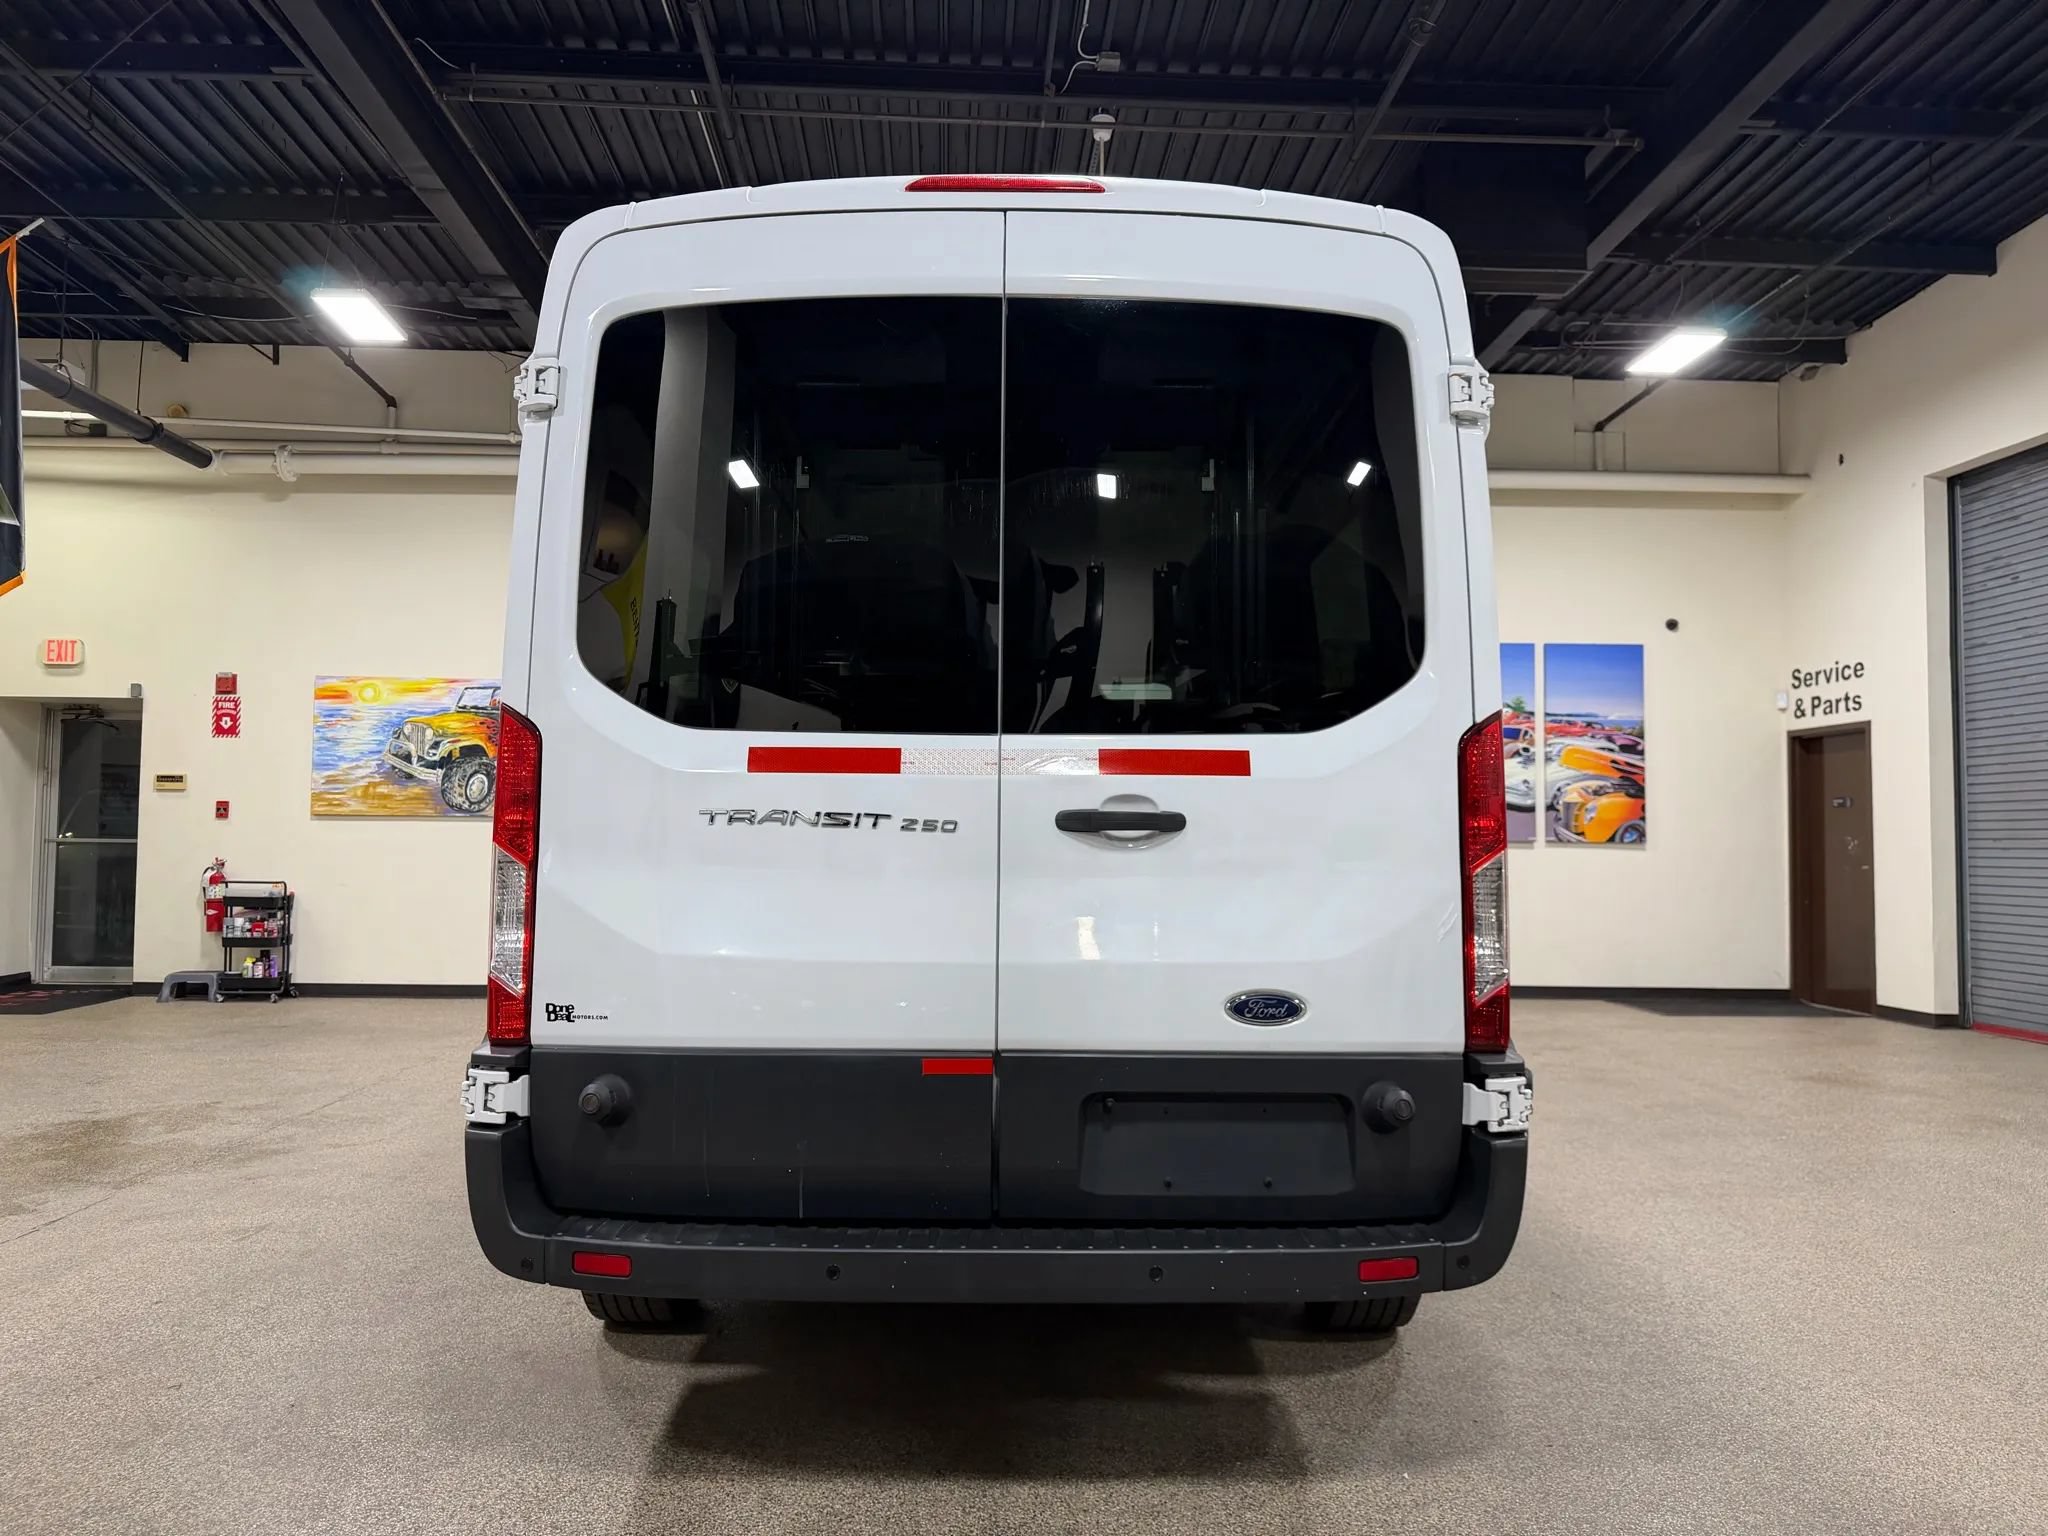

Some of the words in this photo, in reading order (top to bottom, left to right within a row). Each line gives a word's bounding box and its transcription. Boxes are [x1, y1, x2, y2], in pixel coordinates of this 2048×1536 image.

[47, 639, 77, 662] EXIT
[1791, 660, 1864, 689] Service
[218, 701, 236, 709] FIRE
[1794, 698, 1806, 719] &
[1811, 691, 1862, 717] Parts
[699, 809, 892, 829] TRANSIT
[900, 817, 958, 833] 250
[545, 1003, 575, 1014] Done
[1244, 999, 1288, 1018] Ford
